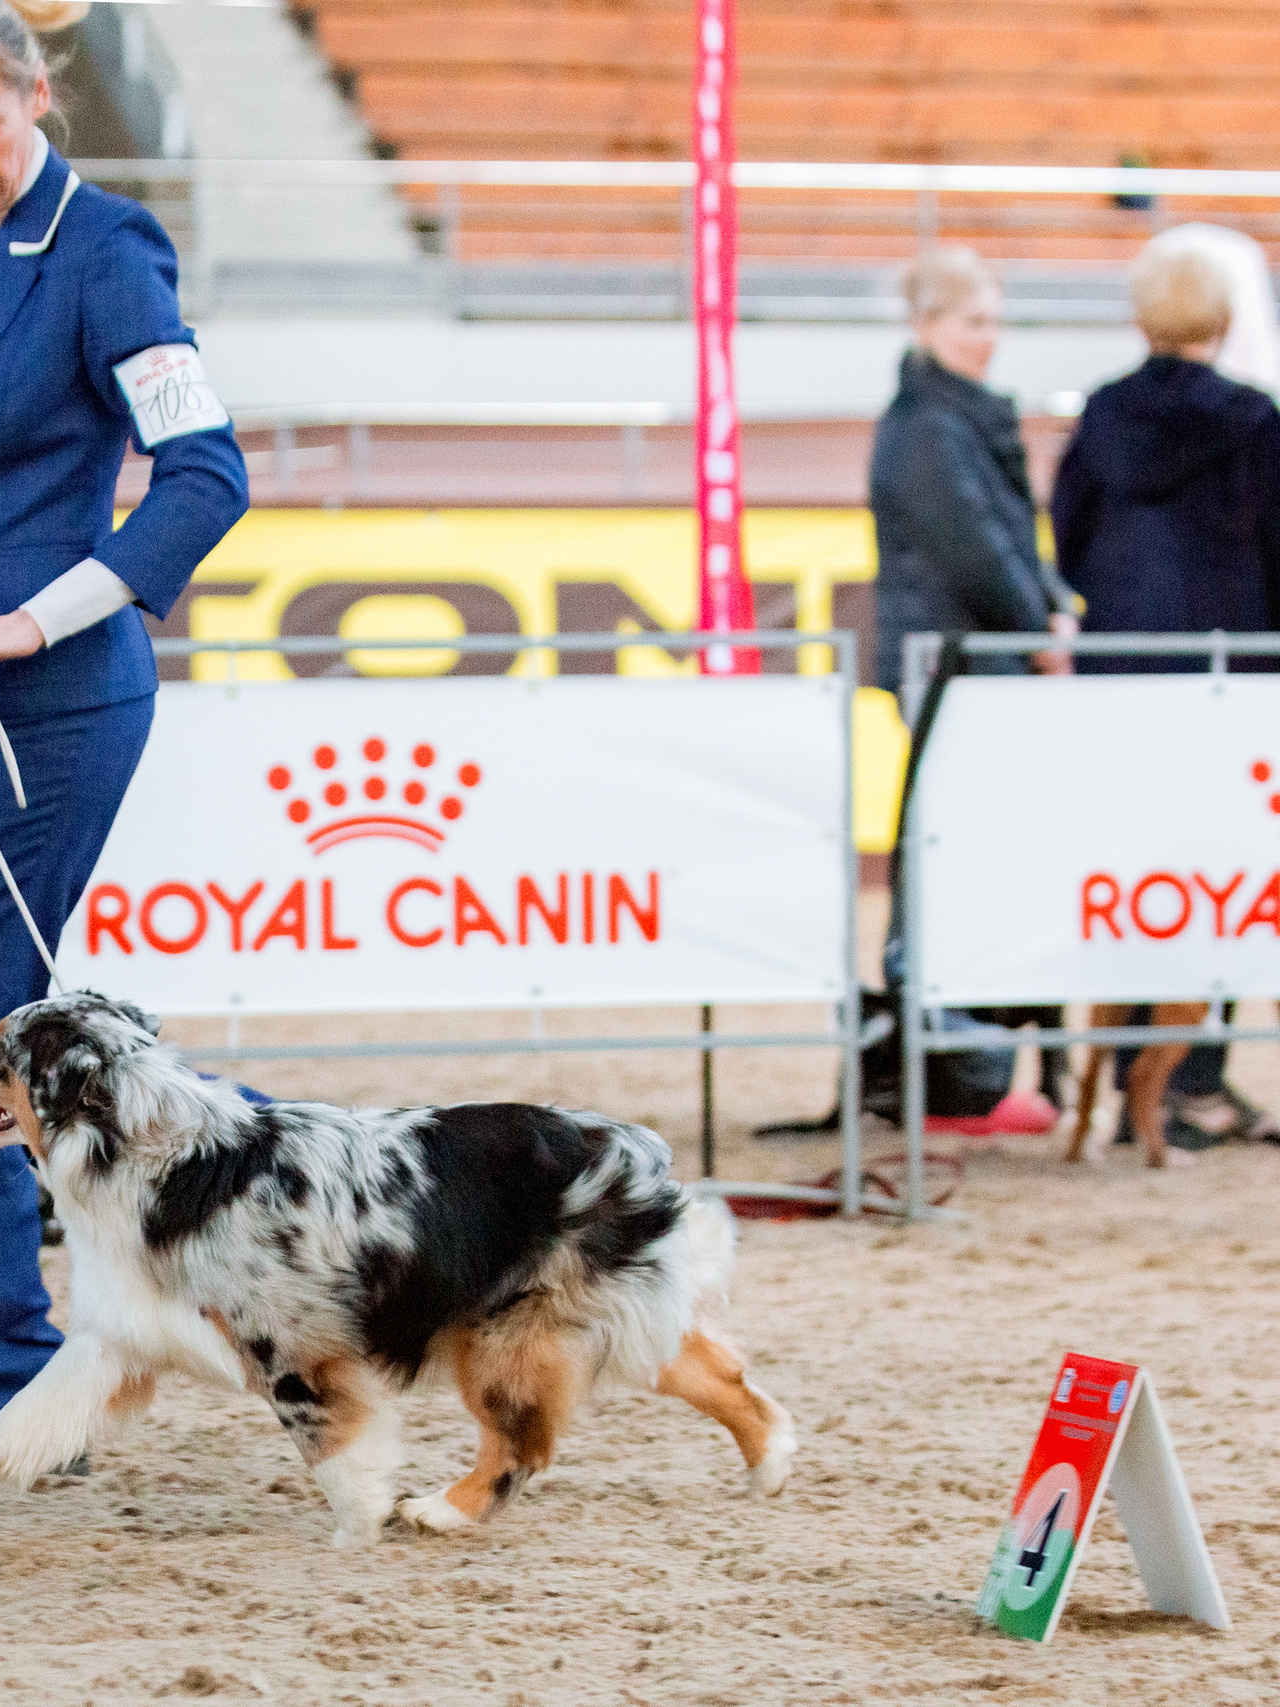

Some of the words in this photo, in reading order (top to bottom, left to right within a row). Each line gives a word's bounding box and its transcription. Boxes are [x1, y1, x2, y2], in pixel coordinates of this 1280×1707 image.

[149, 369, 202, 428] 108
[86, 880, 358, 956] ROYAL
[385, 872, 660, 948] CANIN
[1081, 872, 1280, 940] ROYA
[1019, 1490, 1068, 1588] 4
